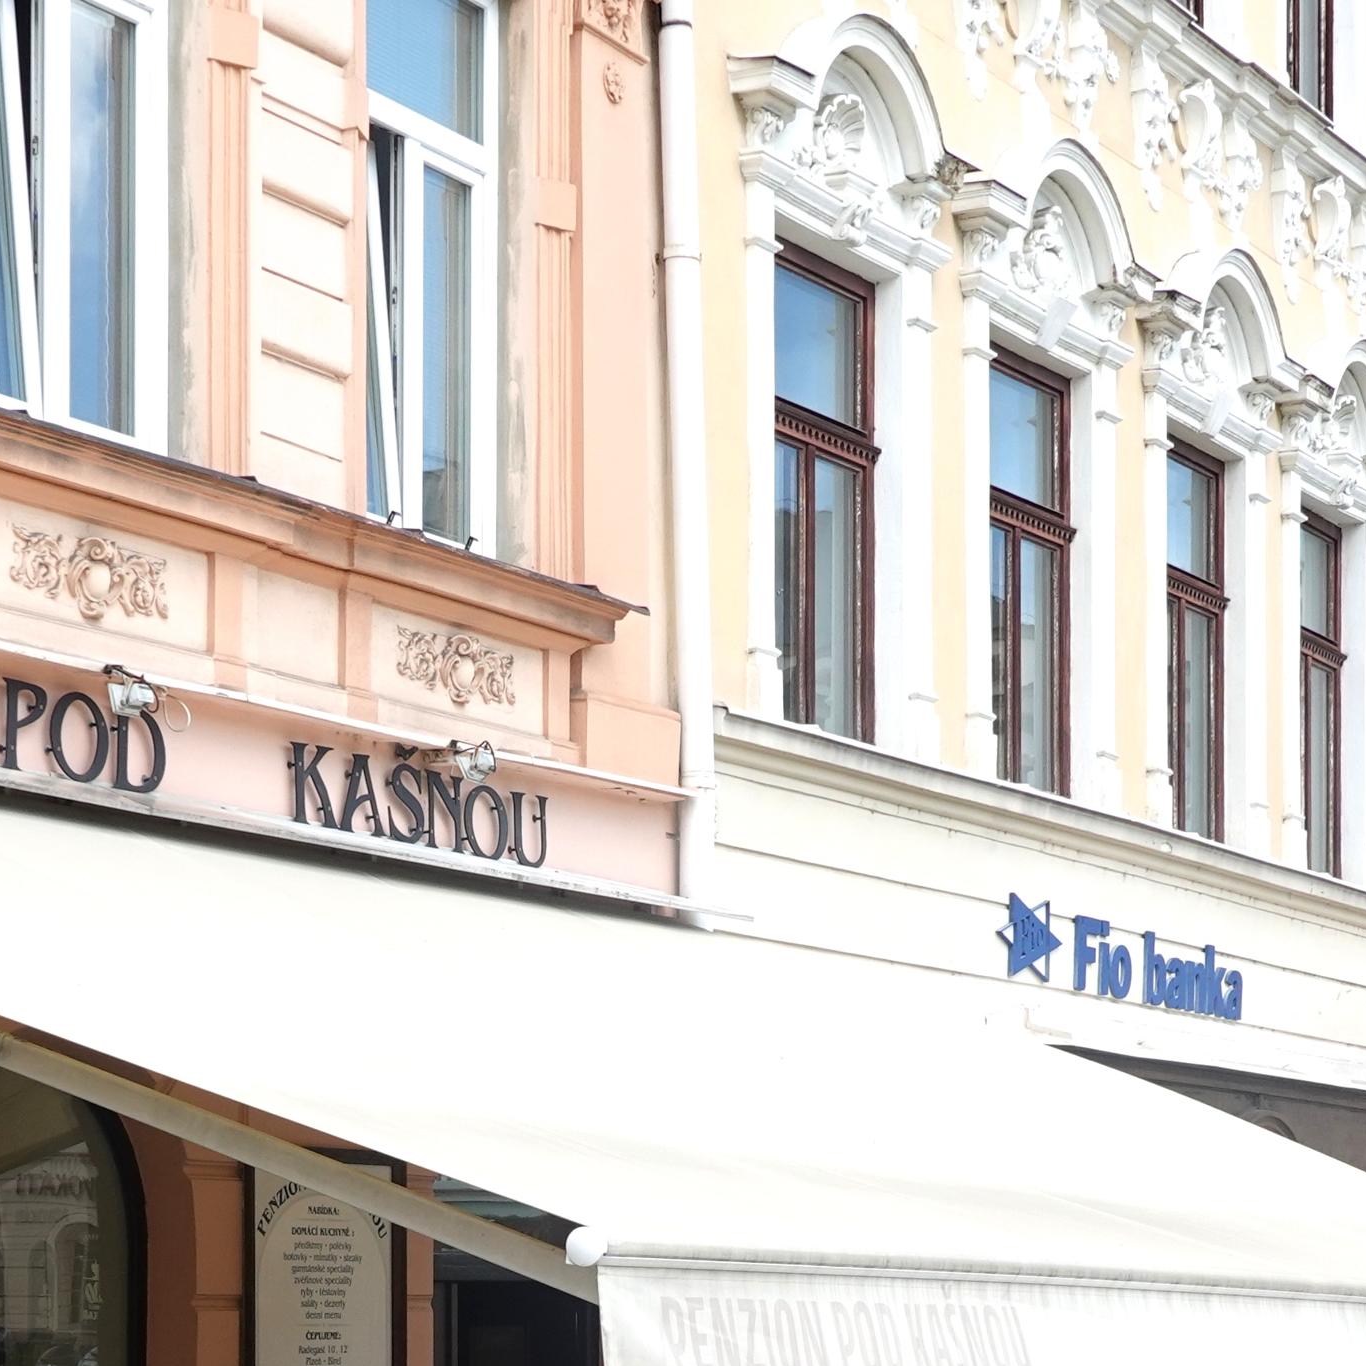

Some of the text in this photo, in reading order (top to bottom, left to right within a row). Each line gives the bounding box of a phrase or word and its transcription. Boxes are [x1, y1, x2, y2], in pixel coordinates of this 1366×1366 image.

[2, 676, 166, 793] POD
[290, 741, 548, 868] KAŠNOU
[1073, 914, 1243, 1021] Fio banka
